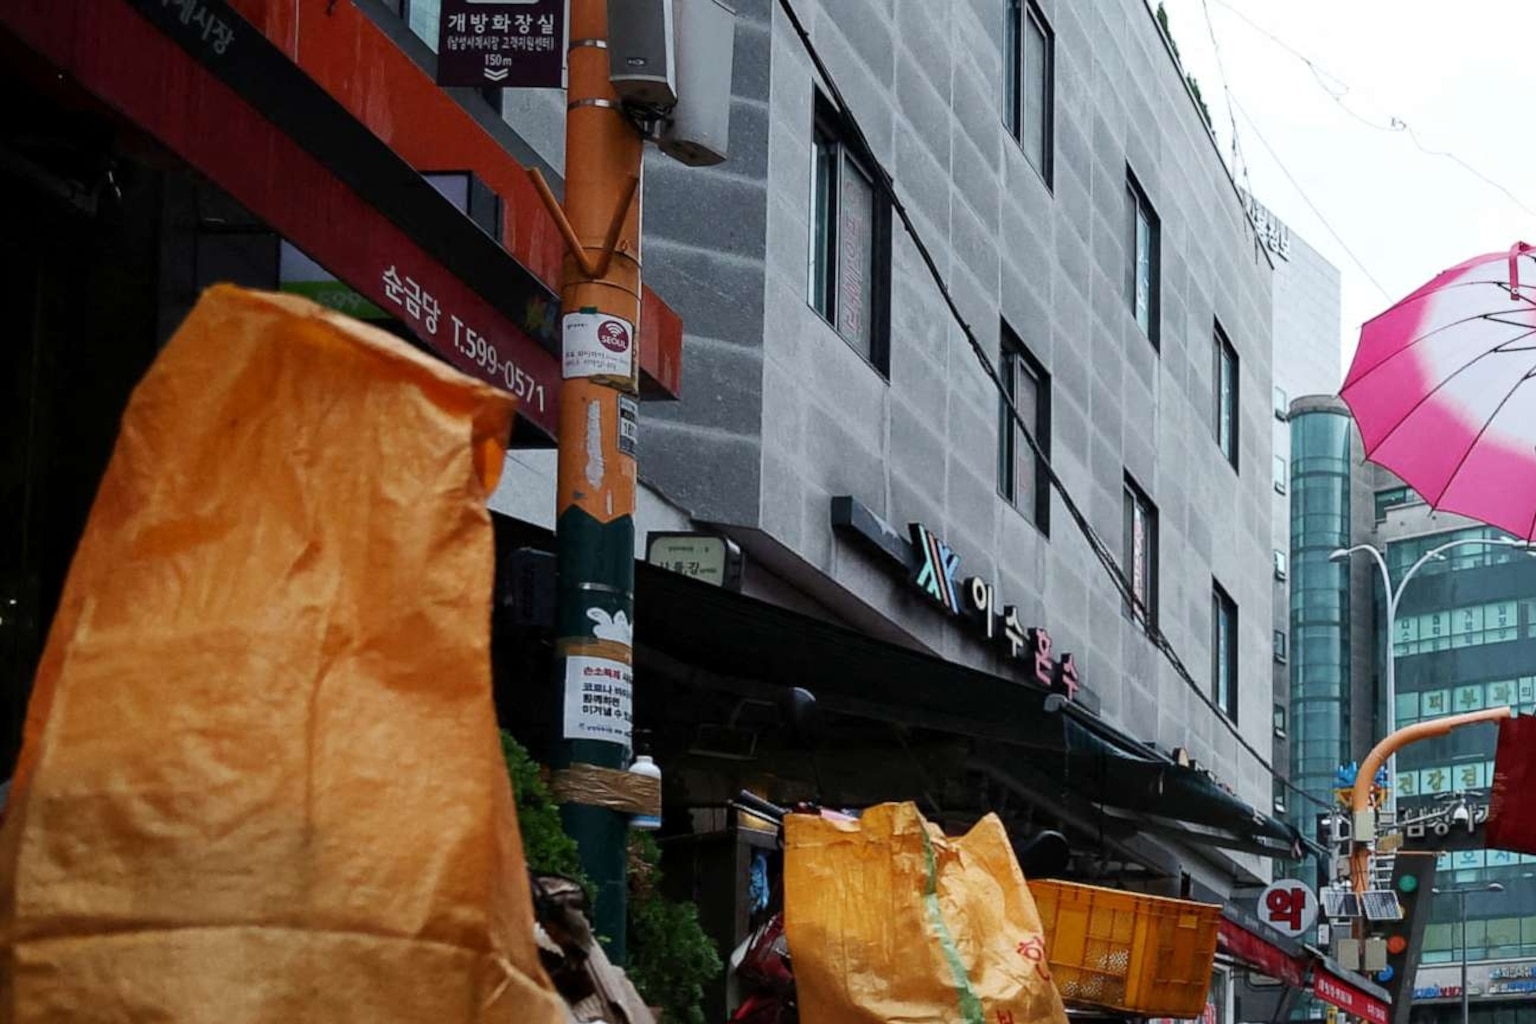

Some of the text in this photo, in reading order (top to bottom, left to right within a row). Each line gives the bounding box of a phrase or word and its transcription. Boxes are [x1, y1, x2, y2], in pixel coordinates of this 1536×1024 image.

[448, 13, 555, 34] 개방화장실
[485, 53, 513, 67] 150m
[383, 265, 545, 413] 순금당 T.599-0571
[601, 335, 627, 350] SEOUL
[582, 682, 612, 695] 코로나
[582, 705, 612, 717] 이겨낼
[614, 710, 622, 719] 수
[1266, 888, 1306, 931] 약
